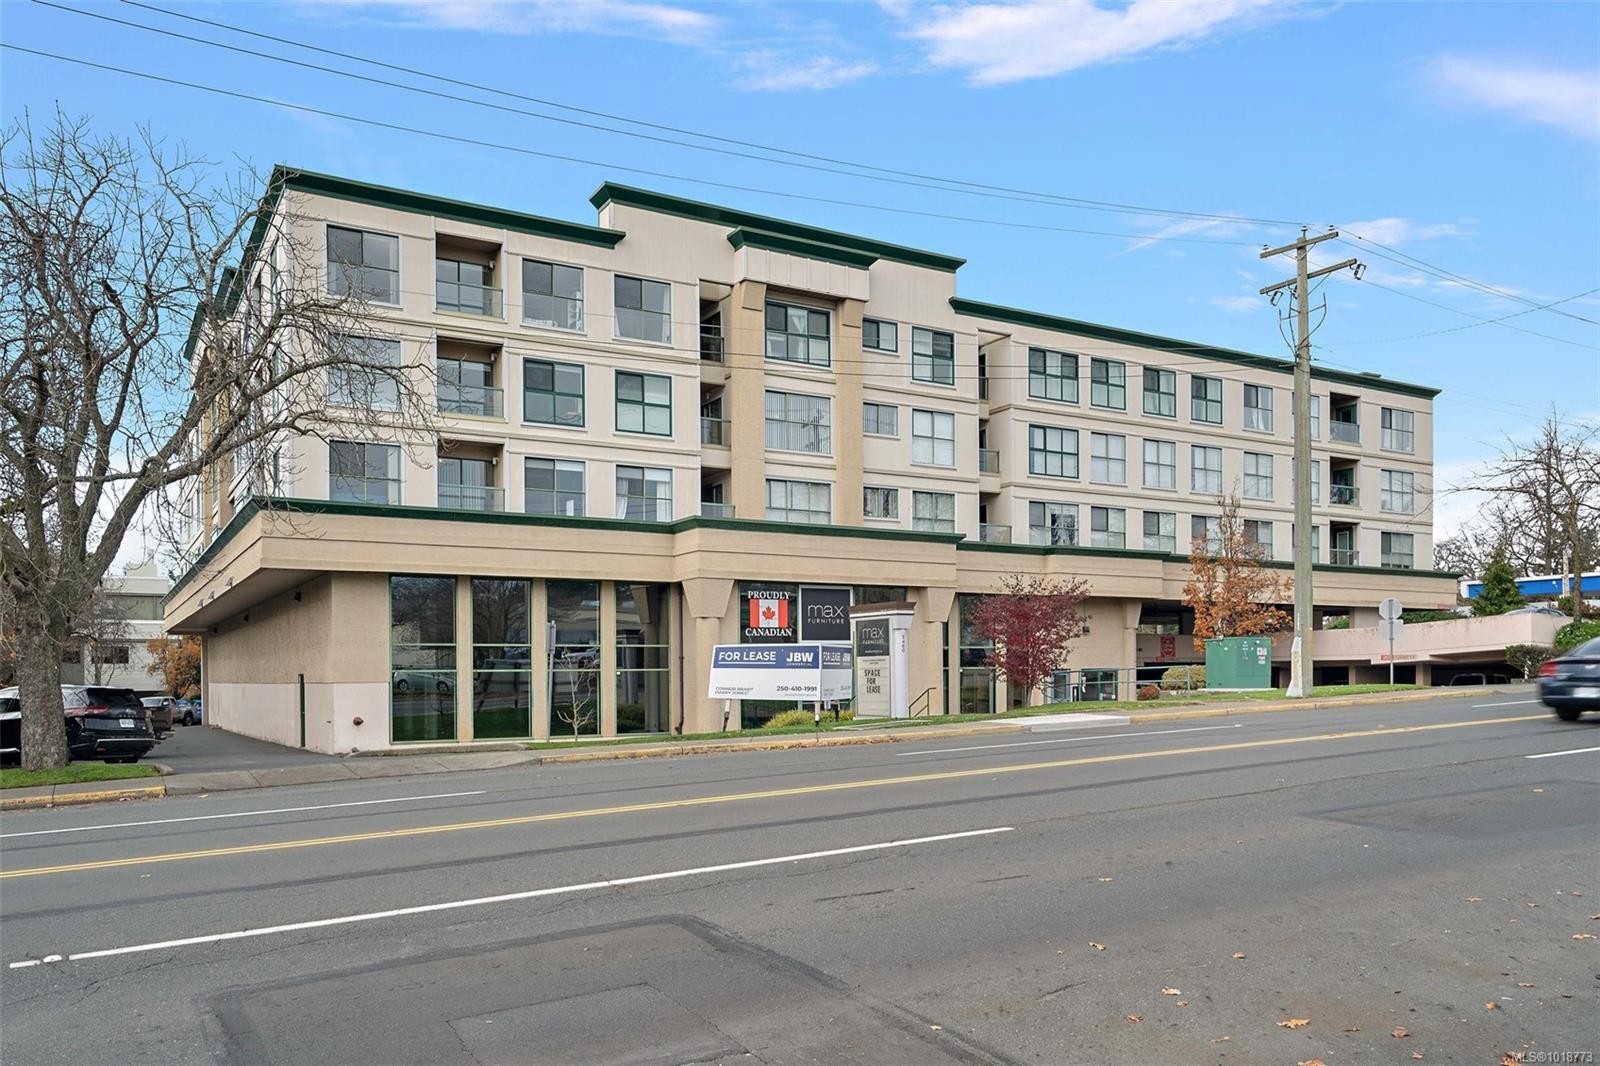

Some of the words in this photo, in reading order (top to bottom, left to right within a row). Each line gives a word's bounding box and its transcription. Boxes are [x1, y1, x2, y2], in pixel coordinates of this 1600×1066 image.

[747, 590, 791, 600] PROUDLY
[808, 604, 844, 618] max
[745, 628, 793, 637] CANADIAN
[862, 627, 885, 639] max
[718, 651, 741, 661] FOR
[743, 651, 777, 661] LEASE
[786, 652, 814, 662] JBW
[864, 669, 881, 677] SPACE
[866, 677, 876, 685] FOR
[866, 685, 881, 693] LEASE
